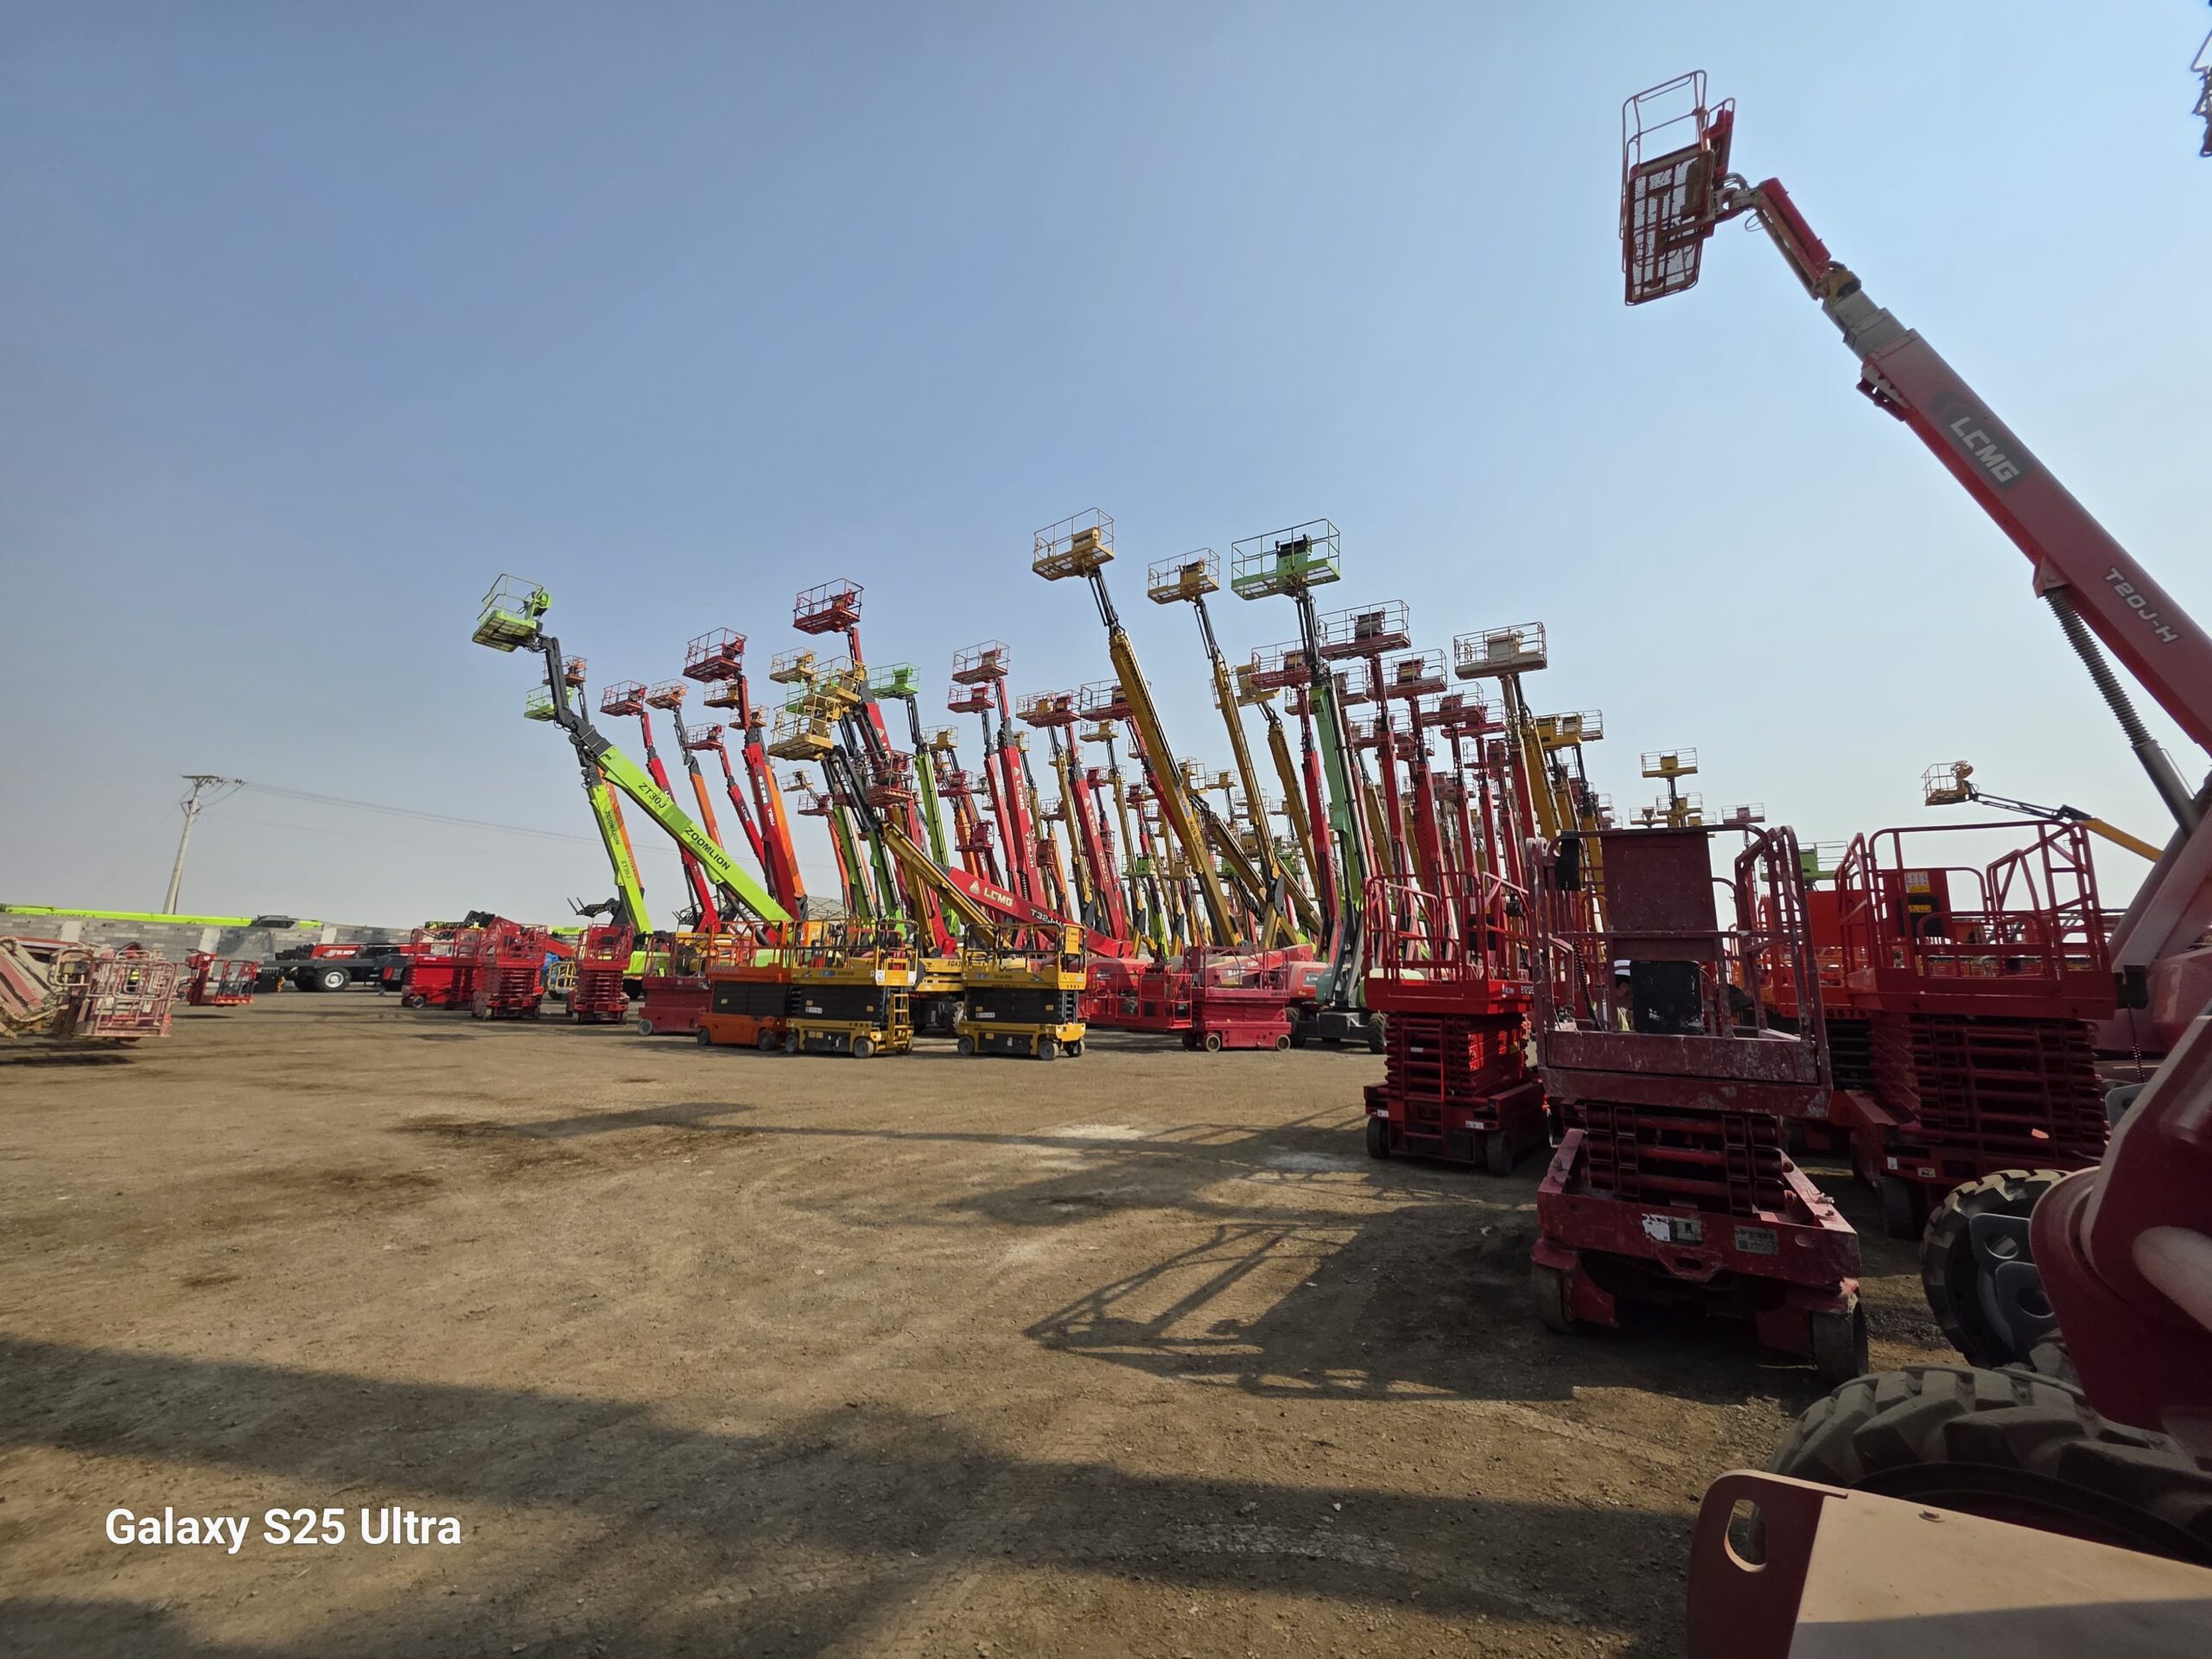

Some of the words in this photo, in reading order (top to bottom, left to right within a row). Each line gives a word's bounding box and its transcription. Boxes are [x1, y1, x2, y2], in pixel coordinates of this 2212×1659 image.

[2105, 568, 2179, 644] T20J-H
[639, 782, 668, 809] ZT30J
[604, 810, 621, 846] ZOOMLION
[683, 826, 732, 871] ZOOMLION
